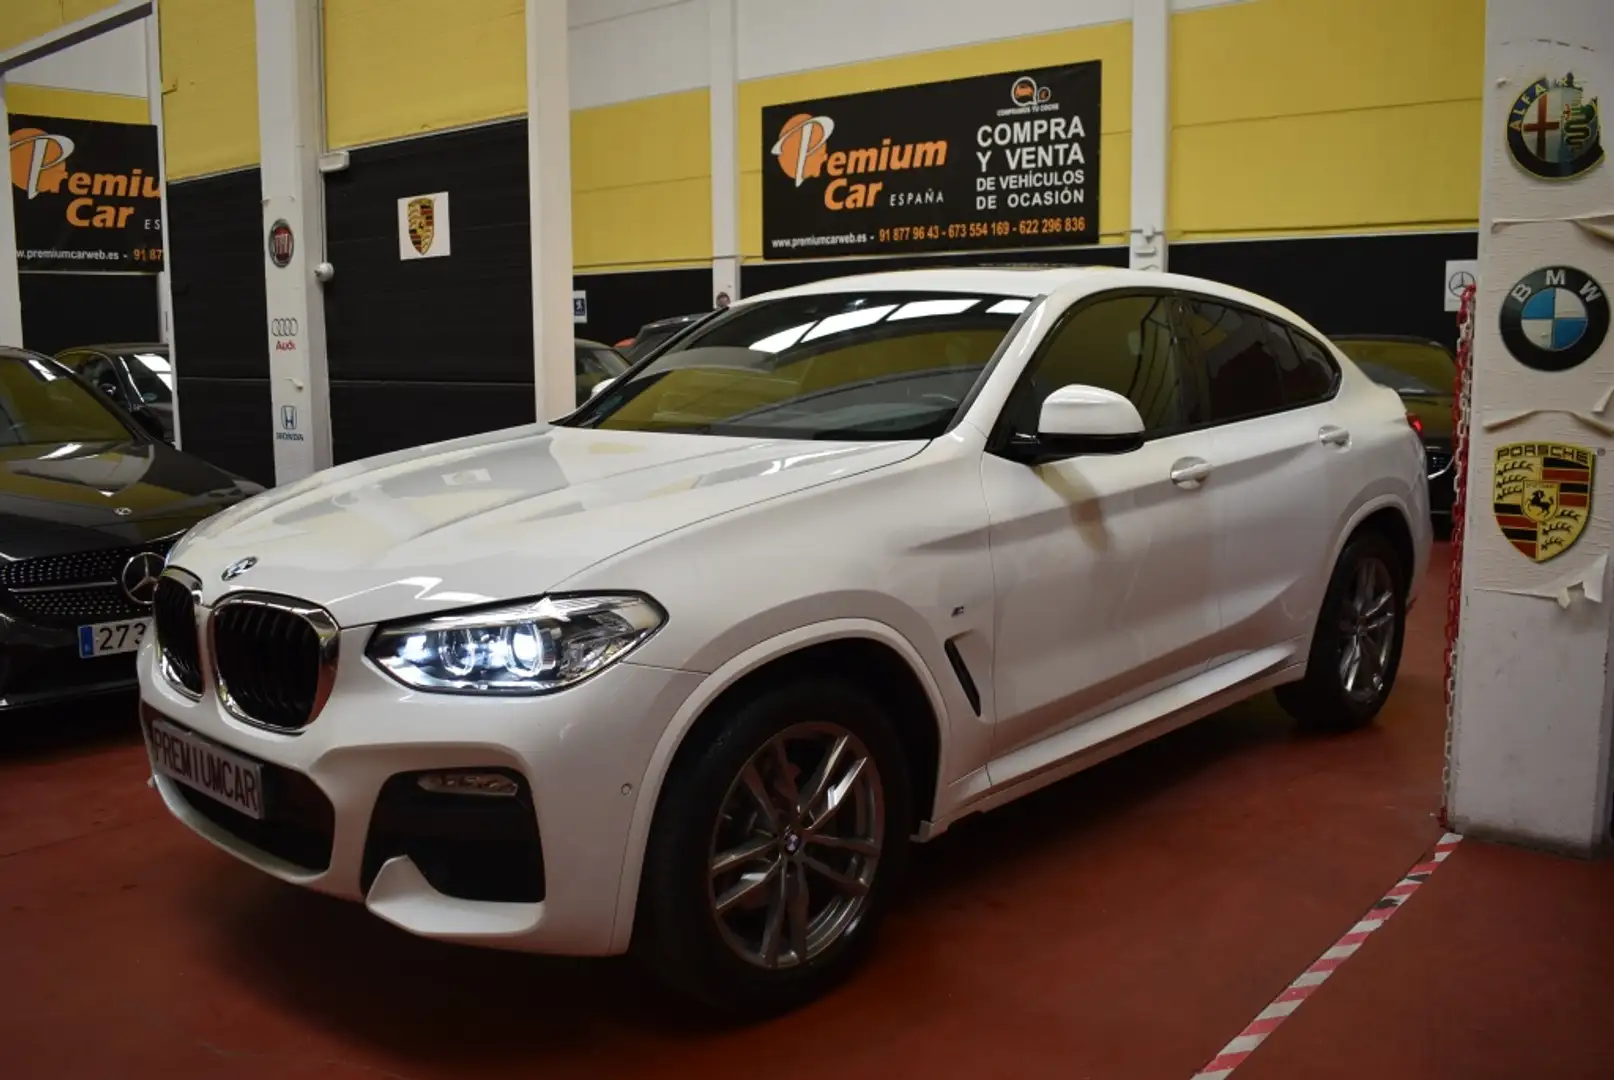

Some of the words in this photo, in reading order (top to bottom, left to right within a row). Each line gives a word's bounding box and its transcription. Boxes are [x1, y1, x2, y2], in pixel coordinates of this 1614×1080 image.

[977, 115, 1086, 147] COMPRA
[771, 115, 948, 188] Premium
[976, 150, 992, 173] Y
[1005, 142, 1085, 170] VENTA
[824, 177, 883, 211] Car
[889, 188, 944, 207] ESPAÑA
[976, 176, 996, 192] DE
[999, 169, 1085, 190] VEHÍCULOS
[66, 197, 135, 228] Car
[976, 195, 997, 210] DE
[1007, 186, 1084, 208] OCASIÓN
[771, 232, 867, 248] www.premiumcarweb.es
[879, 228, 890, 242] 91
[893, 227, 910, 240] 877
[913, 226, 925, 239] 96
[927, 225, 939, 239] 43
[948, 223, 967, 238] 673
[969, 222, 988, 237] 554
[991, 220, 1010, 235] 169
[1019, 219, 1038, 234] 622
[1041, 217, 1062, 232] 296
[1064, 216, 1085, 231] 836
[133, 249, 145, 260] 91
[1511, 269, 1602, 302] BMW
[275, 340, 297, 350] Audi
[276, 431, 303, 441] HONDA
[1498, 444, 1588, 465] PORSCHE
[152, 726, 259, 812] PREMIUMCAR
